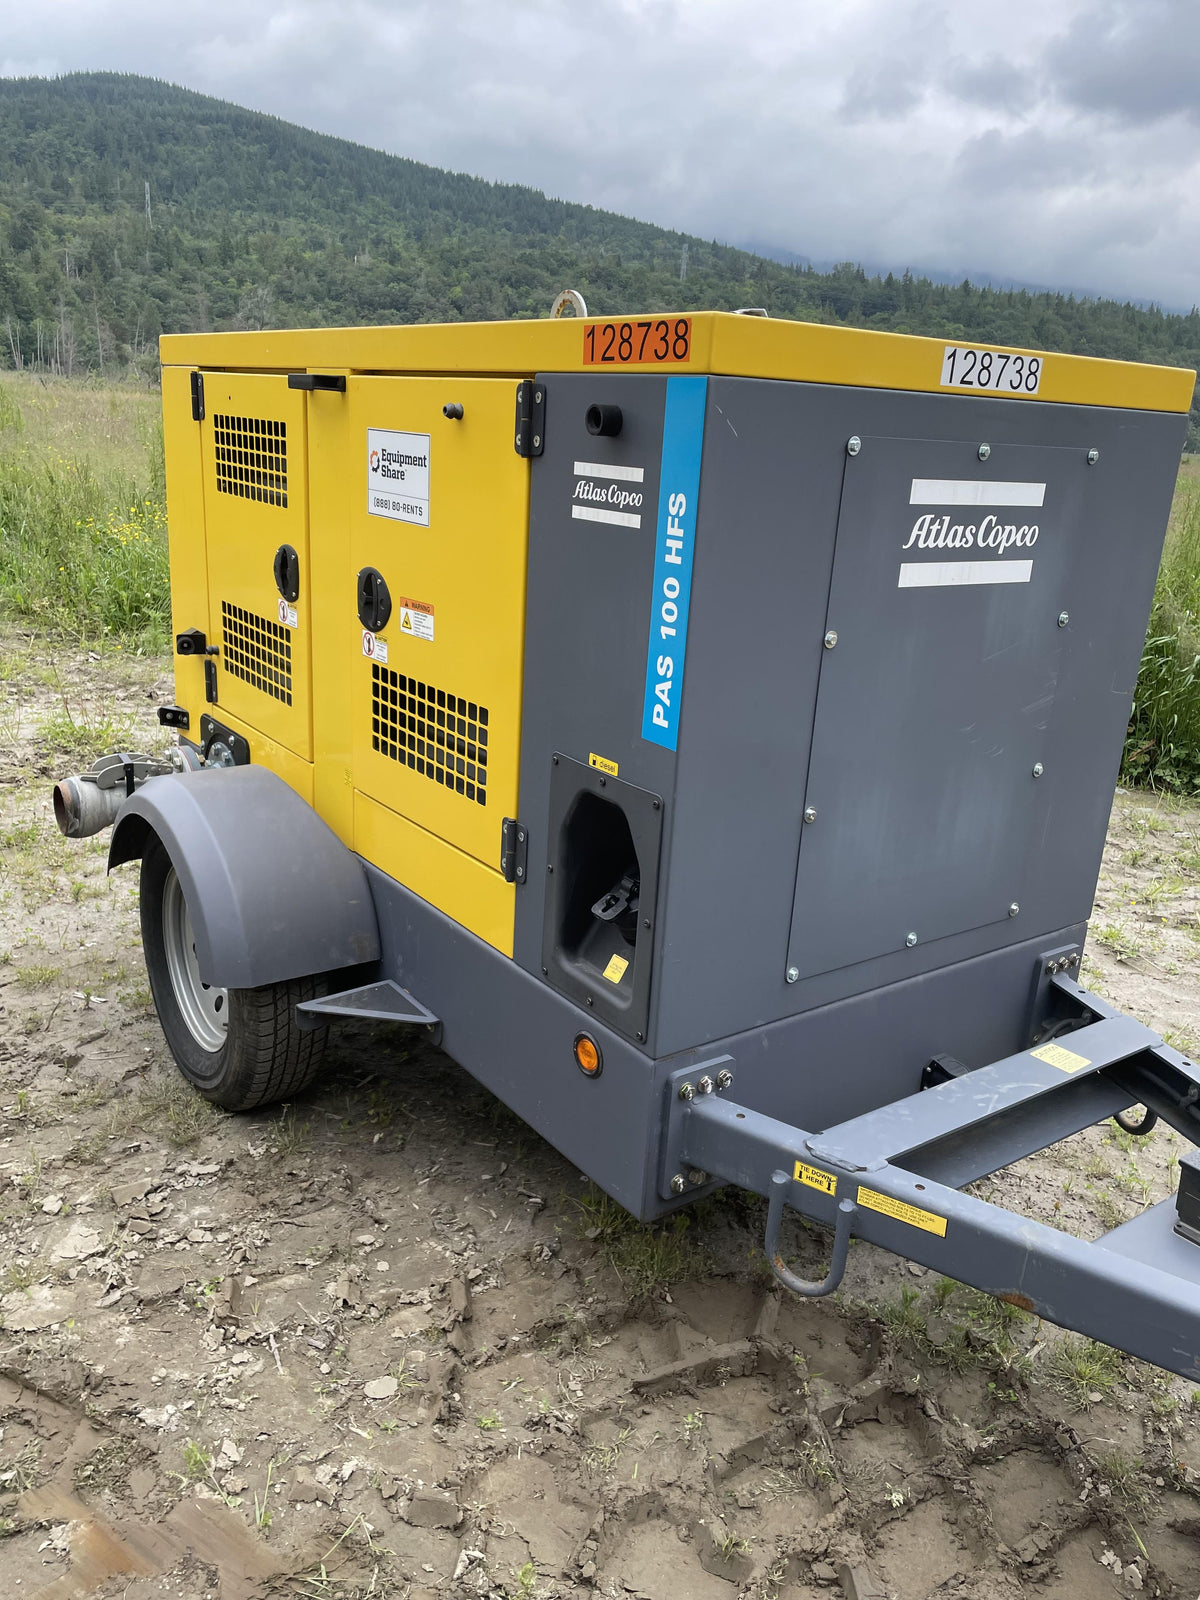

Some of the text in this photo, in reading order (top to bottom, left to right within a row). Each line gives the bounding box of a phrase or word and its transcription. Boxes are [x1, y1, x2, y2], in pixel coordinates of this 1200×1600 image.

[587, 319, 688, 362] 128738
[947, 348, 1040, 391] 128738
[381, 449, 427, 468] Equipment
[381, 465, 405, 480] Share
[572, 480, 643, 508] Atlas Copco
[374, 497, 423, 516] (888) 80-RENTS
[902, 514, 1039, 554] Atlas Copco
[412, 602, 431, 613] WARNING
[652, 492, 687, 728] PAS 100 HFS
[800, 1165, 832, 1181] TIE DOWN
[805, 1175, 824, 1186] HERE
